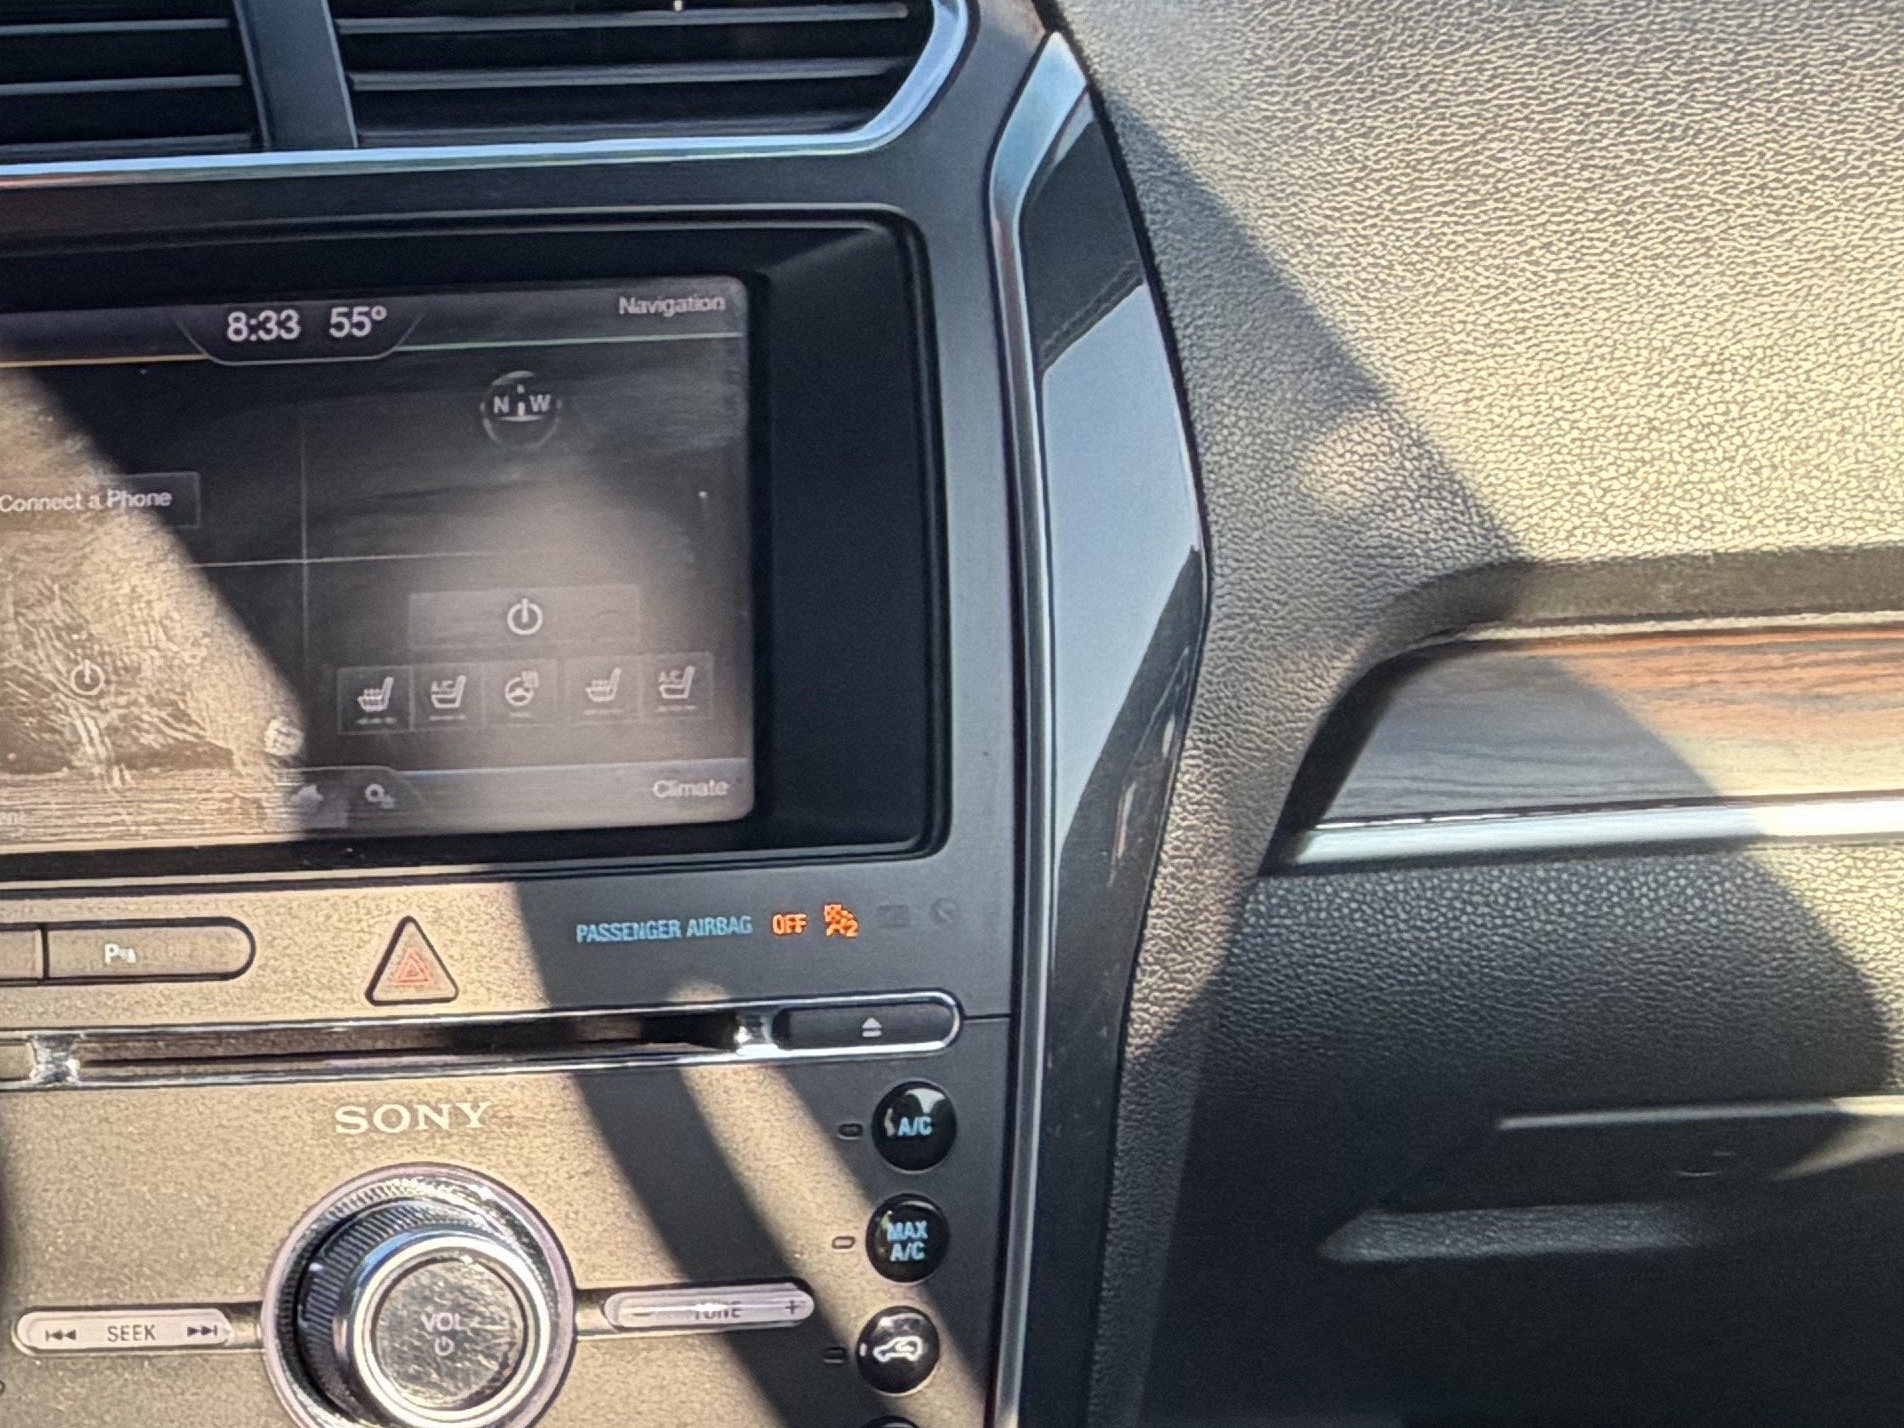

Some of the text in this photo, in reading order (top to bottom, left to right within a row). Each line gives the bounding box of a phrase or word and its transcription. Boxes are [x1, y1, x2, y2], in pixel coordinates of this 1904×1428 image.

[618, 294, 726, 319] Navigation
[226, 305, 387, 343] 8:33 55°
[493, 396, 509, 414] N
[530, 394, 551, 413] W
[88, 495, 100, 509] a
[106, 488, 172, 510] Phone
[652, 778, 729, 800] Climate
[575, 912, 808, 944] PASSENGER AIRBAG OFF
[334, 1101, 493, 1134] SONY
[898, 1115, 933, 1137] A/C
[887, 1220, 927, 1241] MAX
[890, 1241, 925, 1262] A/C
[421, 1312, 467, 1332] VOL
[107, 1324, 156, 1343] SEEK
